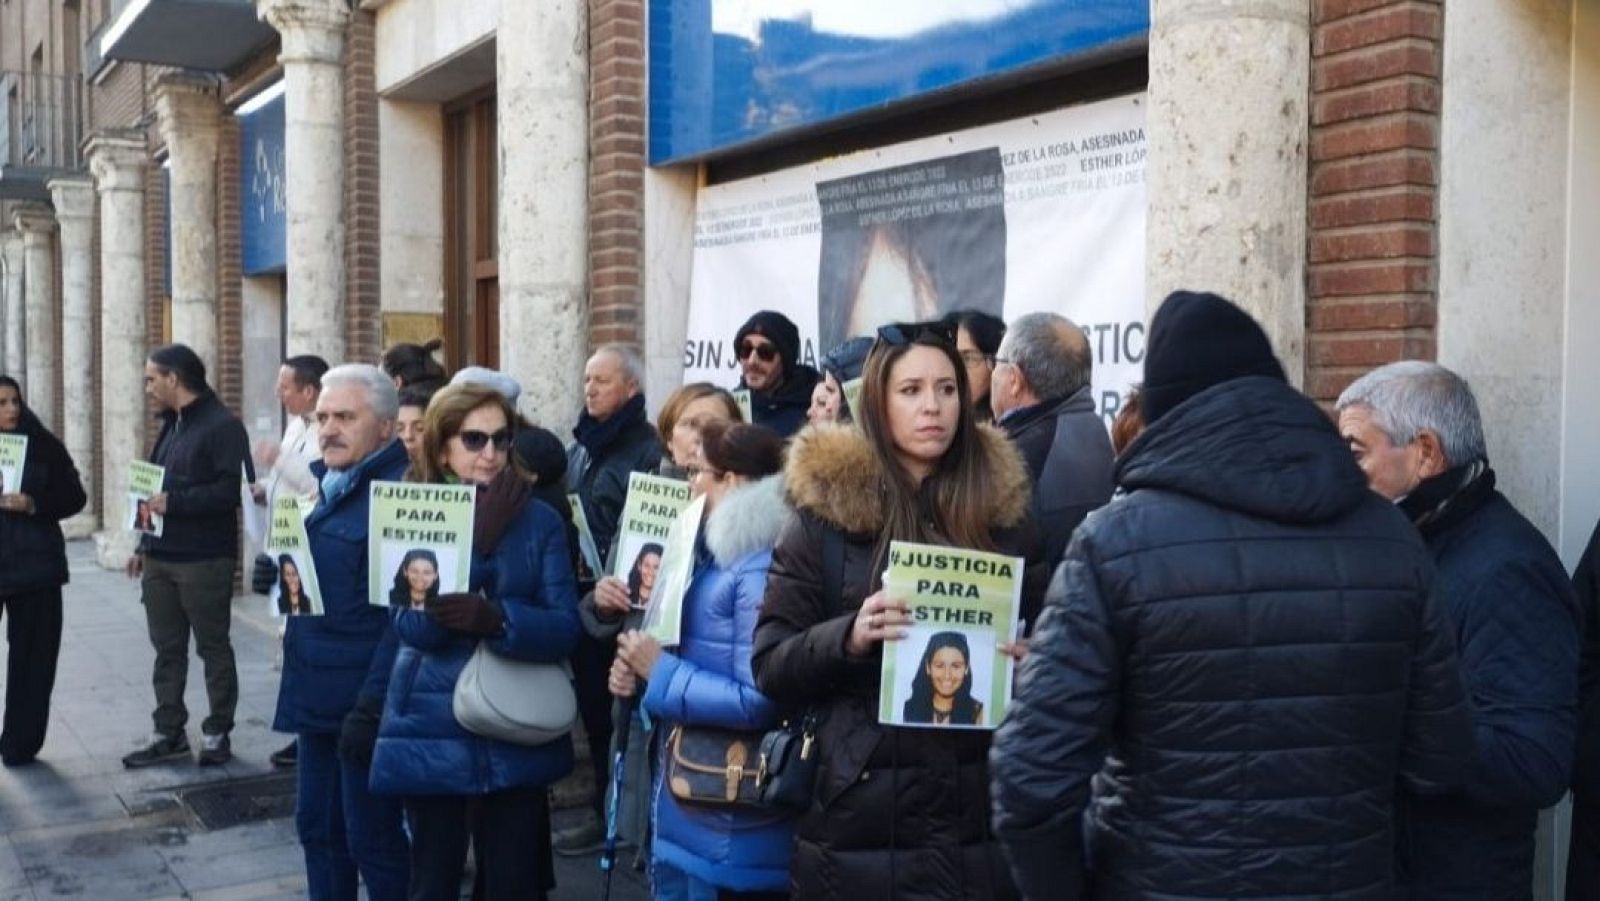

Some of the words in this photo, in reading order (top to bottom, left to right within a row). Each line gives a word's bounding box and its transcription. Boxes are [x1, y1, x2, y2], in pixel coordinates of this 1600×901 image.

[1017, 149, 1029, 163] DE
[1033, 146, 1046, 160] LA
[1080, 128, 1145, 152] ASESINADA
[1080, 152, 1122, 172] ESTHER
[1125, 147, 1147, 165] LÓP
[684, 340, 722, 369] SIN
[373, 486, 472, 503] #JUSTICIA
[631, 478, 692, 500] #JUSTICI
[395, 508, 446, 522] PARA
[640, 501, 677, 519] PARA
[382, 527, 458, 543] ESTHER
[891, 550, 1013, 578] #JUSTICIA
[917, 578, 980, 598] PARA
[914, 605, 993, 626] STHER
